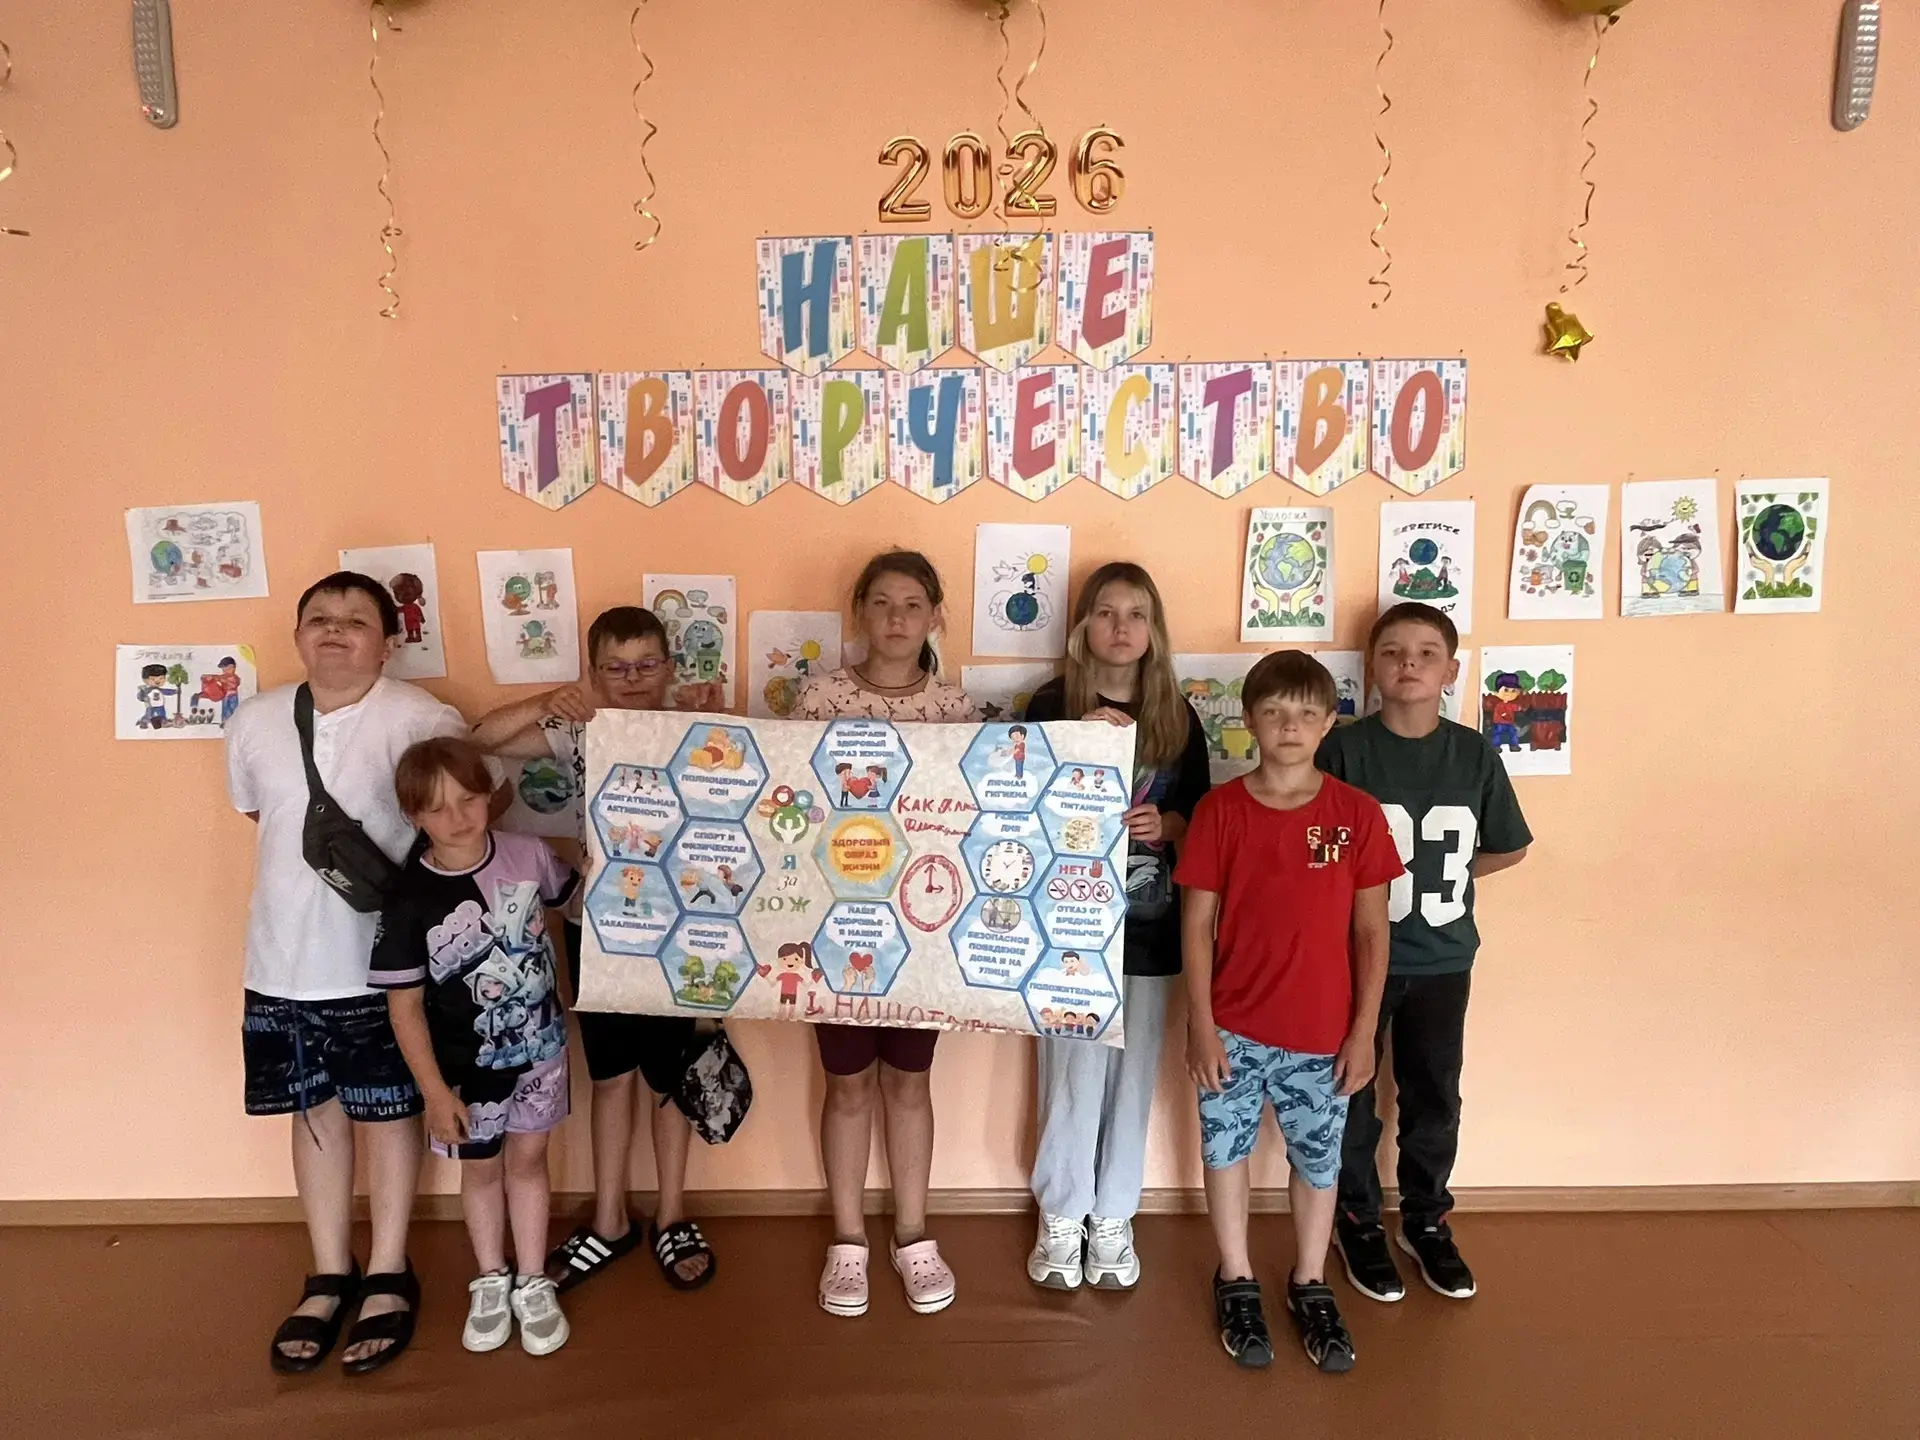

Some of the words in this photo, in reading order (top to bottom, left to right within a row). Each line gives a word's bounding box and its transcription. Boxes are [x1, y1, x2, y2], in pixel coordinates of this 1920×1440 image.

[877, 128, 1129, 223] 2026
[781, 237, 1129, 358] НАШЕ
[523, 367, 1447, 494] ТВОРЧЕСТВО
[837, 740, 886, 748] ЗДОРОВЫЙ
[681, 774, 759, 788] ПОЛНОЦЕННЫЙ
[987, 779, 1027, 788] ЛИЧНАЯ
[708, 788, 729, 797] СОН
[984, 790, 1028, 799] ГИГИЕНА
[1045, 789, 1123, 804] АЦИОНАЛЬНОЕ
[601, 792, 677, 808] ДВИГАТЕЛЬНАЯ
[897, 795, 935, 814] КАК
[606, 804, 670, 819] АКТИВНОСТЬ
[1060, 802, 1105, 813] ПИТАНИЕ
[1001, 824, 1021, 833] ДНЯ
[694, 831, 726, 841] СПОРТ
[728, 834, 735, 842] И
[682, 842, 747, 854] ФИЗИЧЕСКАЯ
[832, 838, 891, 848] ЗДОРОВЫЙ
[689, 853, 738, 865] КУЛЬТУРА
[844, 851, 878, 859] ОБРАЗ
[780, 854, 797, 870] Я
[842, 863, 881, 872] ЖИЗНИ
[1058, 865, 1087, 876] НЕТ
[847, 905, 877, 915] НАШЕ
[1056, 905, 1088, 914] ОТКАЗ
[1089, 907, 1103, 915] ОТ
[599, 919, 667, 932] ЗАКАЛИВАНИЕ
[833, 917, 883, 927] ЗДОРОВЬЕ
[1055, 916, 1102, 927] ВРЕДНЫХ
[688, 928, 729, 939] СВЕЖИЙ
[847, 929, 884, 938] НАШИХ
[968, 931, 1030, 945] БЕЗОПАСНОЕ
[1052, 927, 1105, 938] ПРИВЫЧЕК
[688, 939, 727, 951] ВОЗДУХ
[968, 942, 1026, 956] ПОВЕДЕНИЕ
[968, 953, 997, 964] ДОМА
[999, 957, 1007, 965] И
[1008, 958, 1022, 967] НА
[979, 967, 1010, 977] УЛИЦЕ
[1029, 982, 1114, 998] ПОЛОЖИТЕЛЬНЫЕ
[1051, 995, 1091, 1007] ЭМОЦИИ
